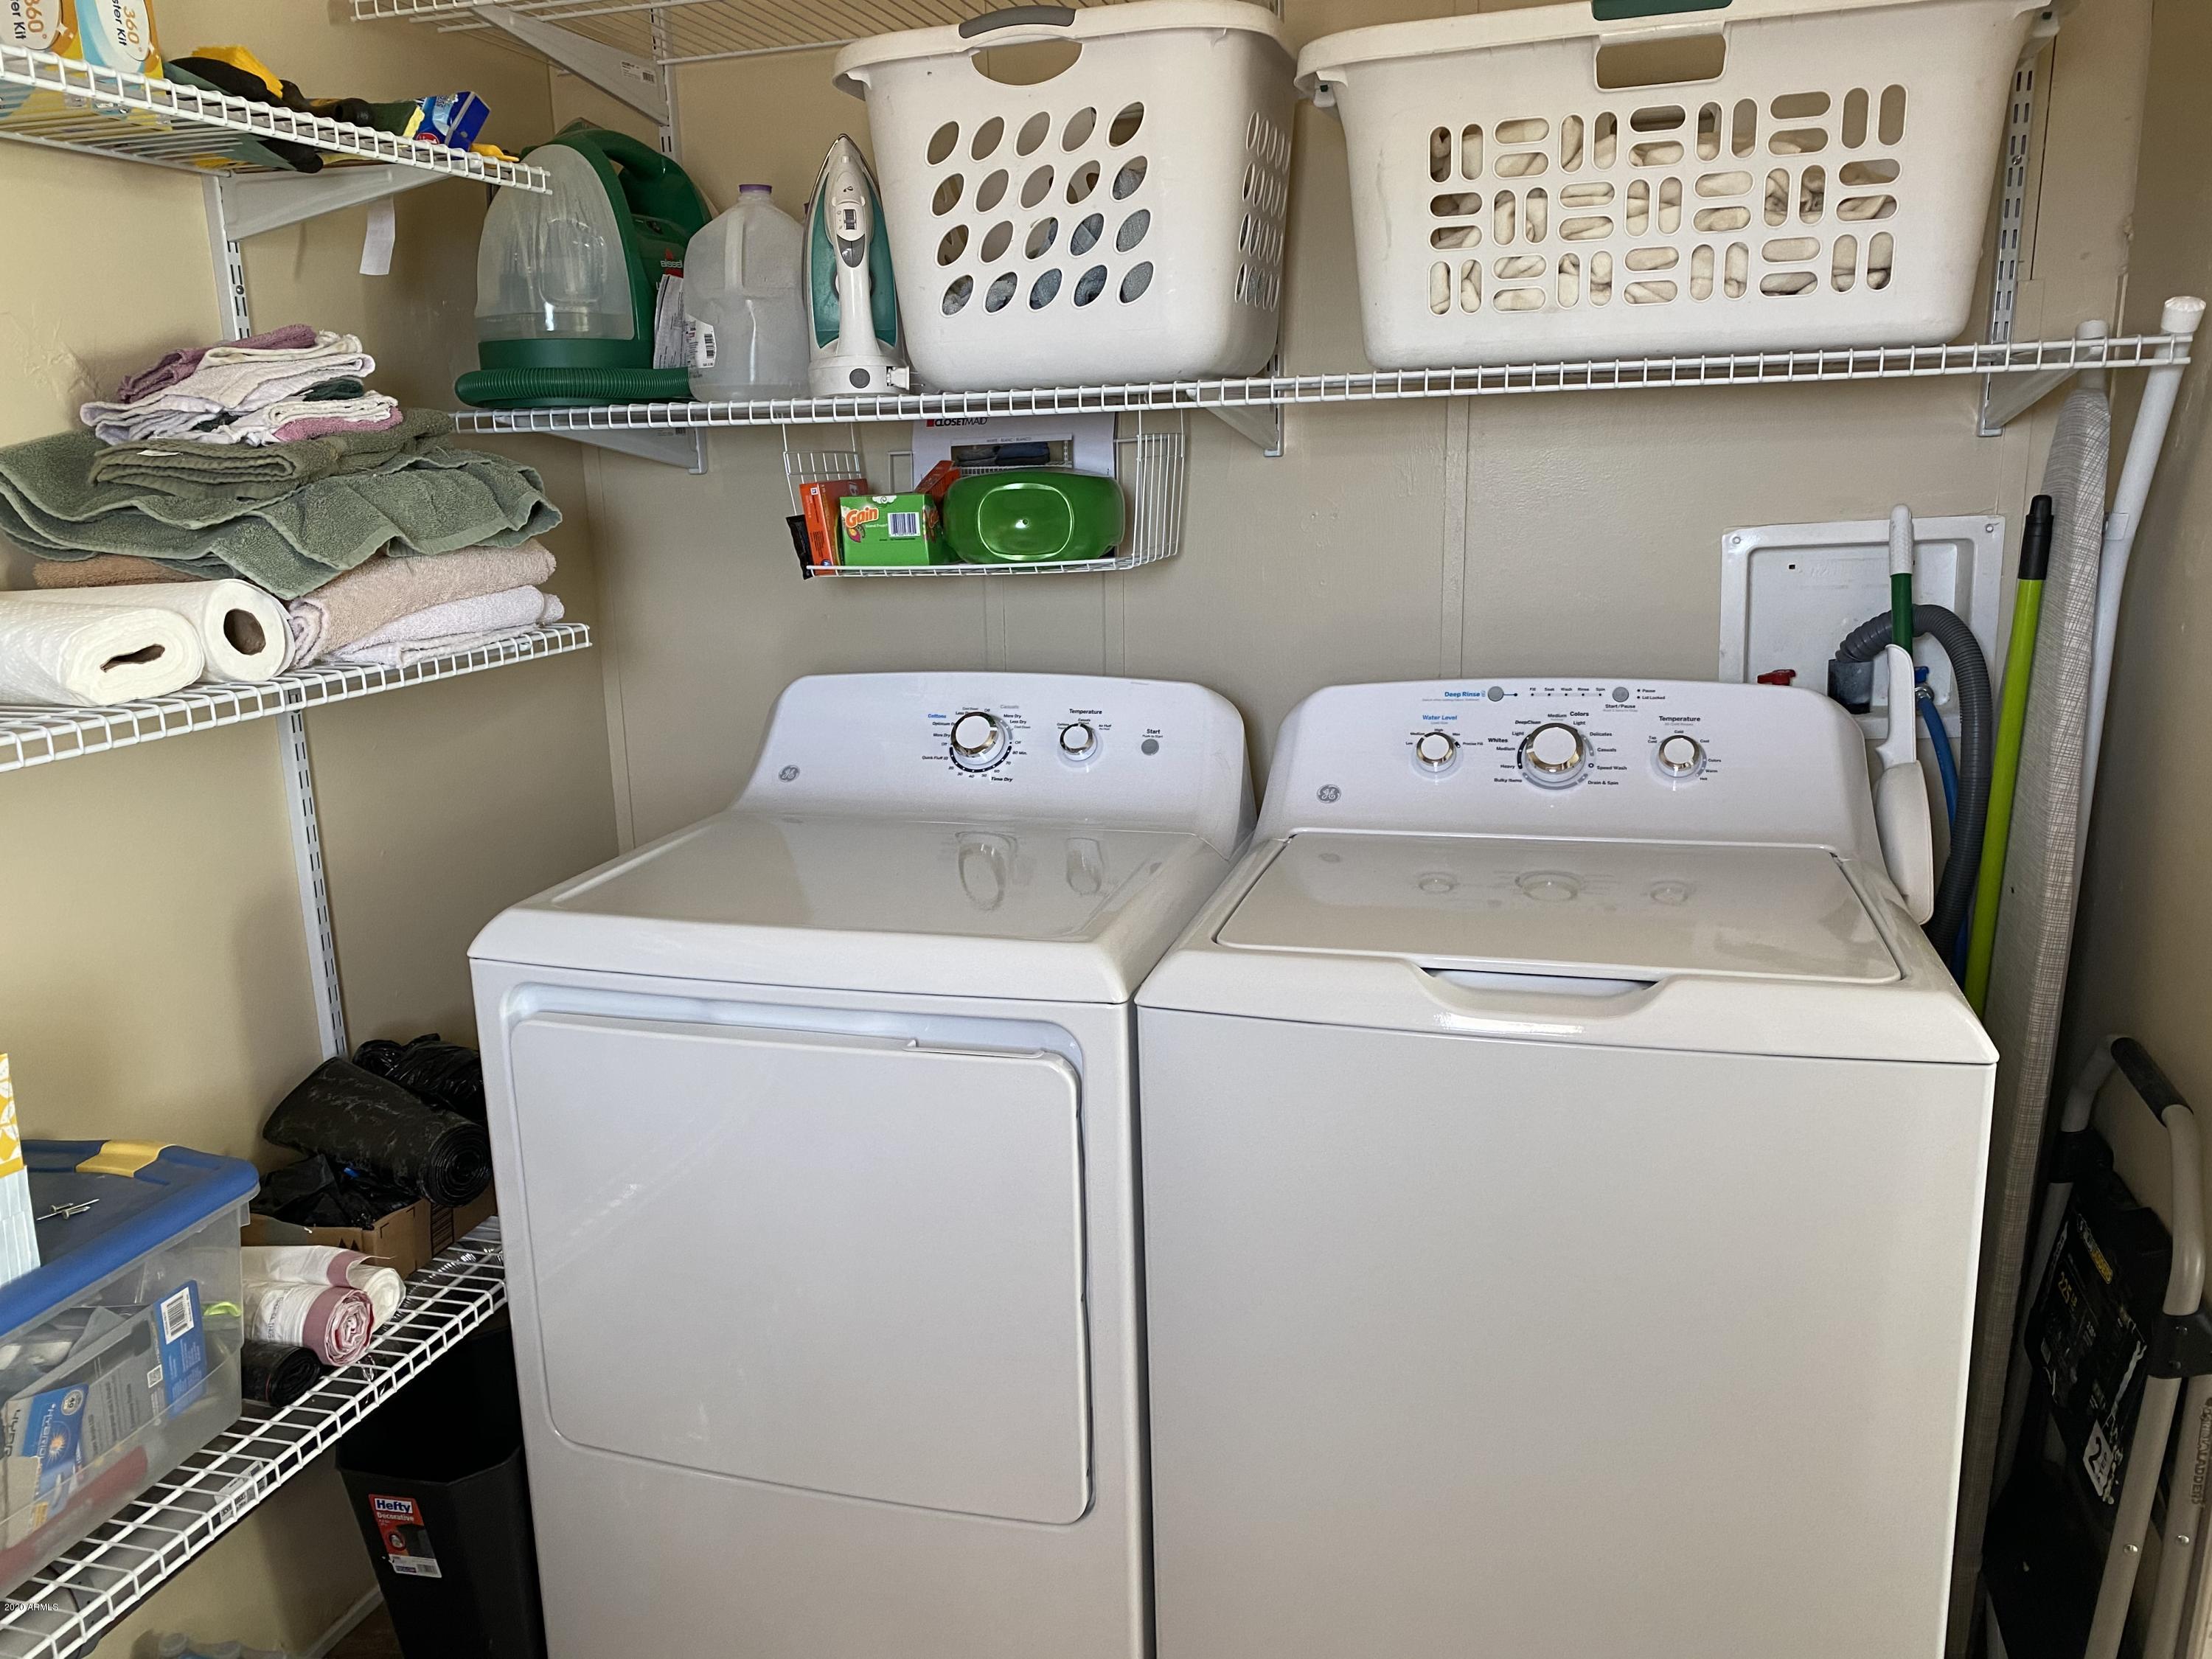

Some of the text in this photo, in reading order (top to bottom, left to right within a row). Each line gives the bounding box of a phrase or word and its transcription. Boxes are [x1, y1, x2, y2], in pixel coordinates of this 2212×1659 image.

[13, 21, 27, 39] Kit
[116, 27, 127, 46] Kit
[934, 417, 987, 427] CLOSETMAID
[846, 507, 879, 528] Gain
[2089, 1436, 2102, 1473] 2
[376, 1499, 411, 1514] Hefty
[377, 1512, 414, 1522] Decorative
